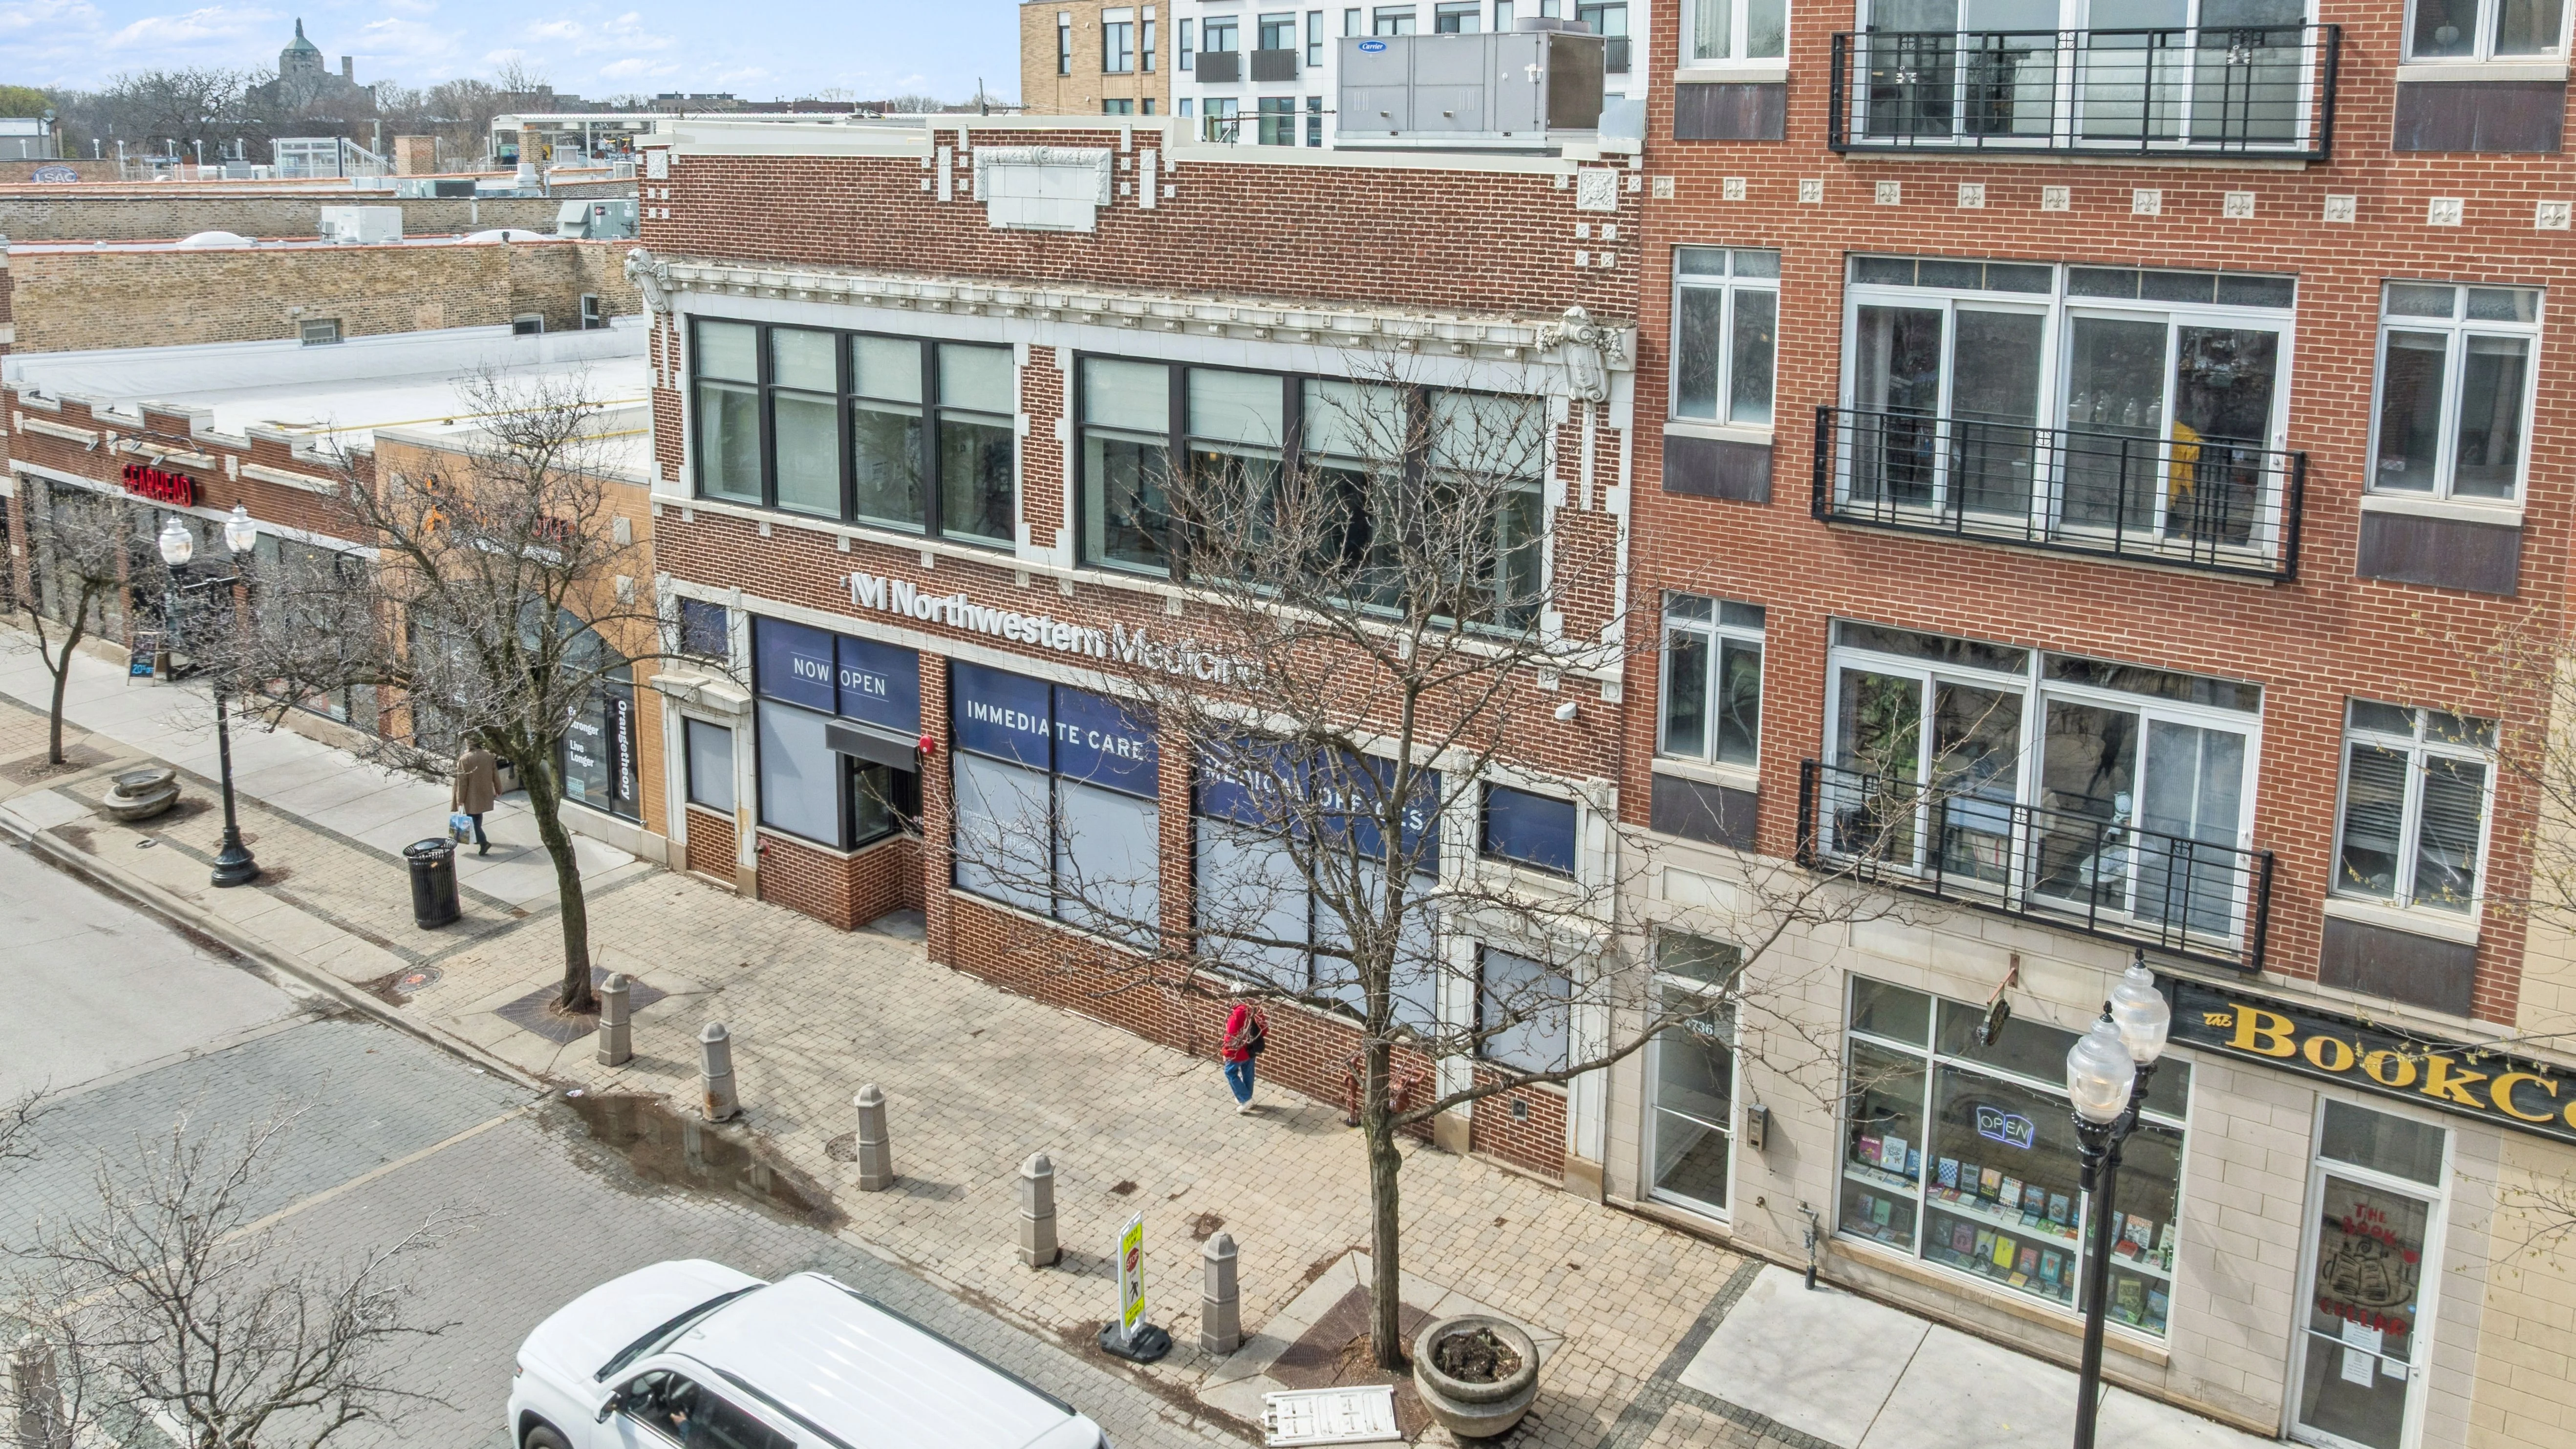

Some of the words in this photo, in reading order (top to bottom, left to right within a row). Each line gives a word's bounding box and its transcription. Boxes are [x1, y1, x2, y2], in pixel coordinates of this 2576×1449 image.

[35, 172, 76, 183] LSAC
[121, 464, 193, 508] GEARHEAD
[892, 579, 1107, 657] Northwestern
[794, 658, 829, 682] NOW
[840, 669, 885, 696] OPEN
[570, 739, 584, 753] Live
[967, 700, 1079, 745] IMMEDIATE
[1088, 730, 1144, 761] CARE
[570, 751, 594, 767] Longer
[618, 700, 630, 800] Orangetheory
[1981, 1116, 2028, 1140] OPEN
[2354, 1203, 2387, 1224] THE
[2342, 1215, 2397, 1246] BOOK
[1127, 1251, 1139, 1269] STOP
[2319, 1297, 2408, 1338] CELLAR
